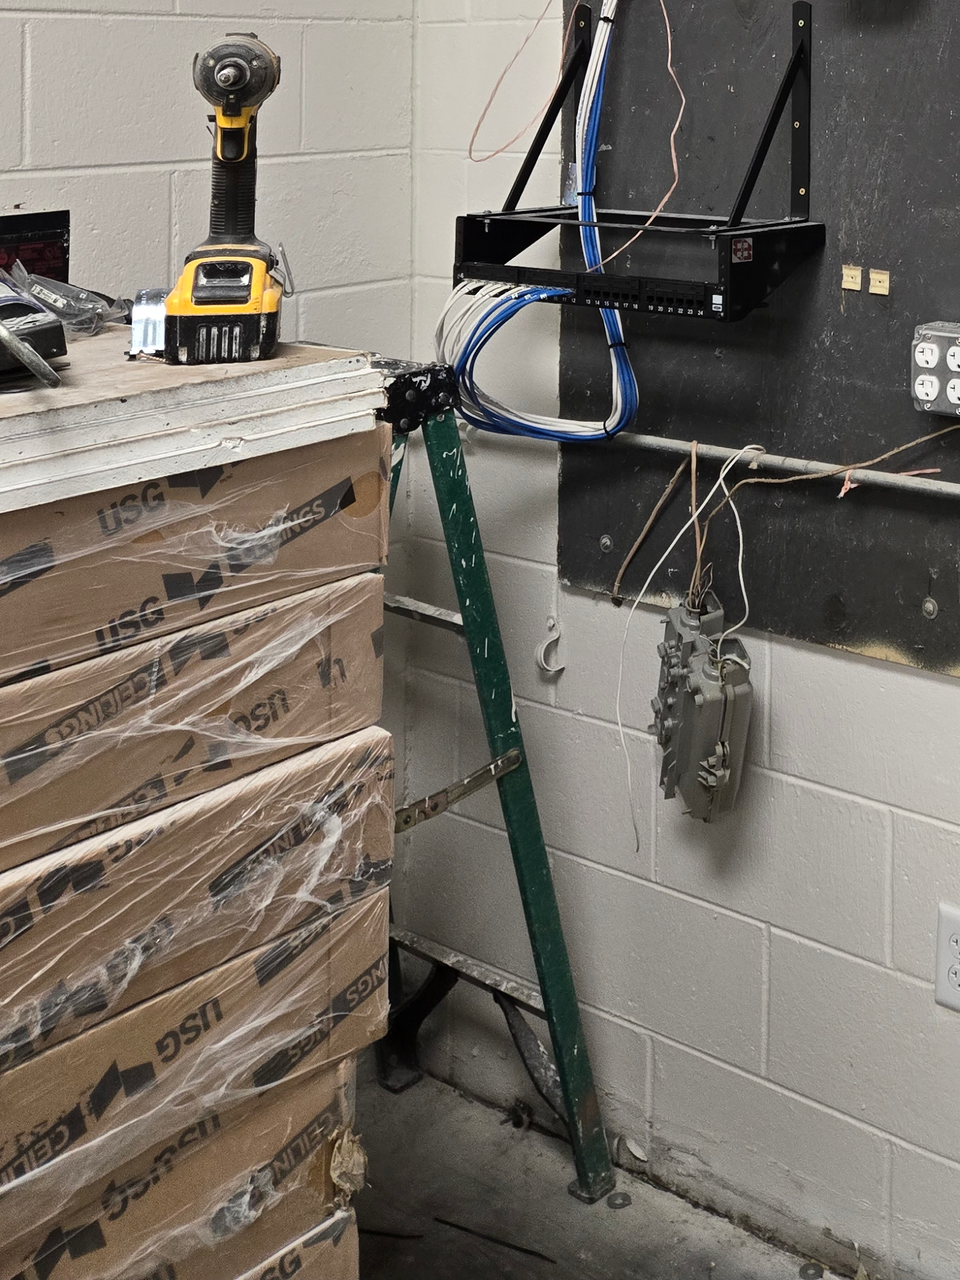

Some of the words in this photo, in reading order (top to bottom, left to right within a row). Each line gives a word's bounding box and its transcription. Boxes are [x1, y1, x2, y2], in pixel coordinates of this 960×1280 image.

[97, 481, 165, 538] USG
[95, 595, 165, 654] USG
[155, 997, 224, 1064] USG
